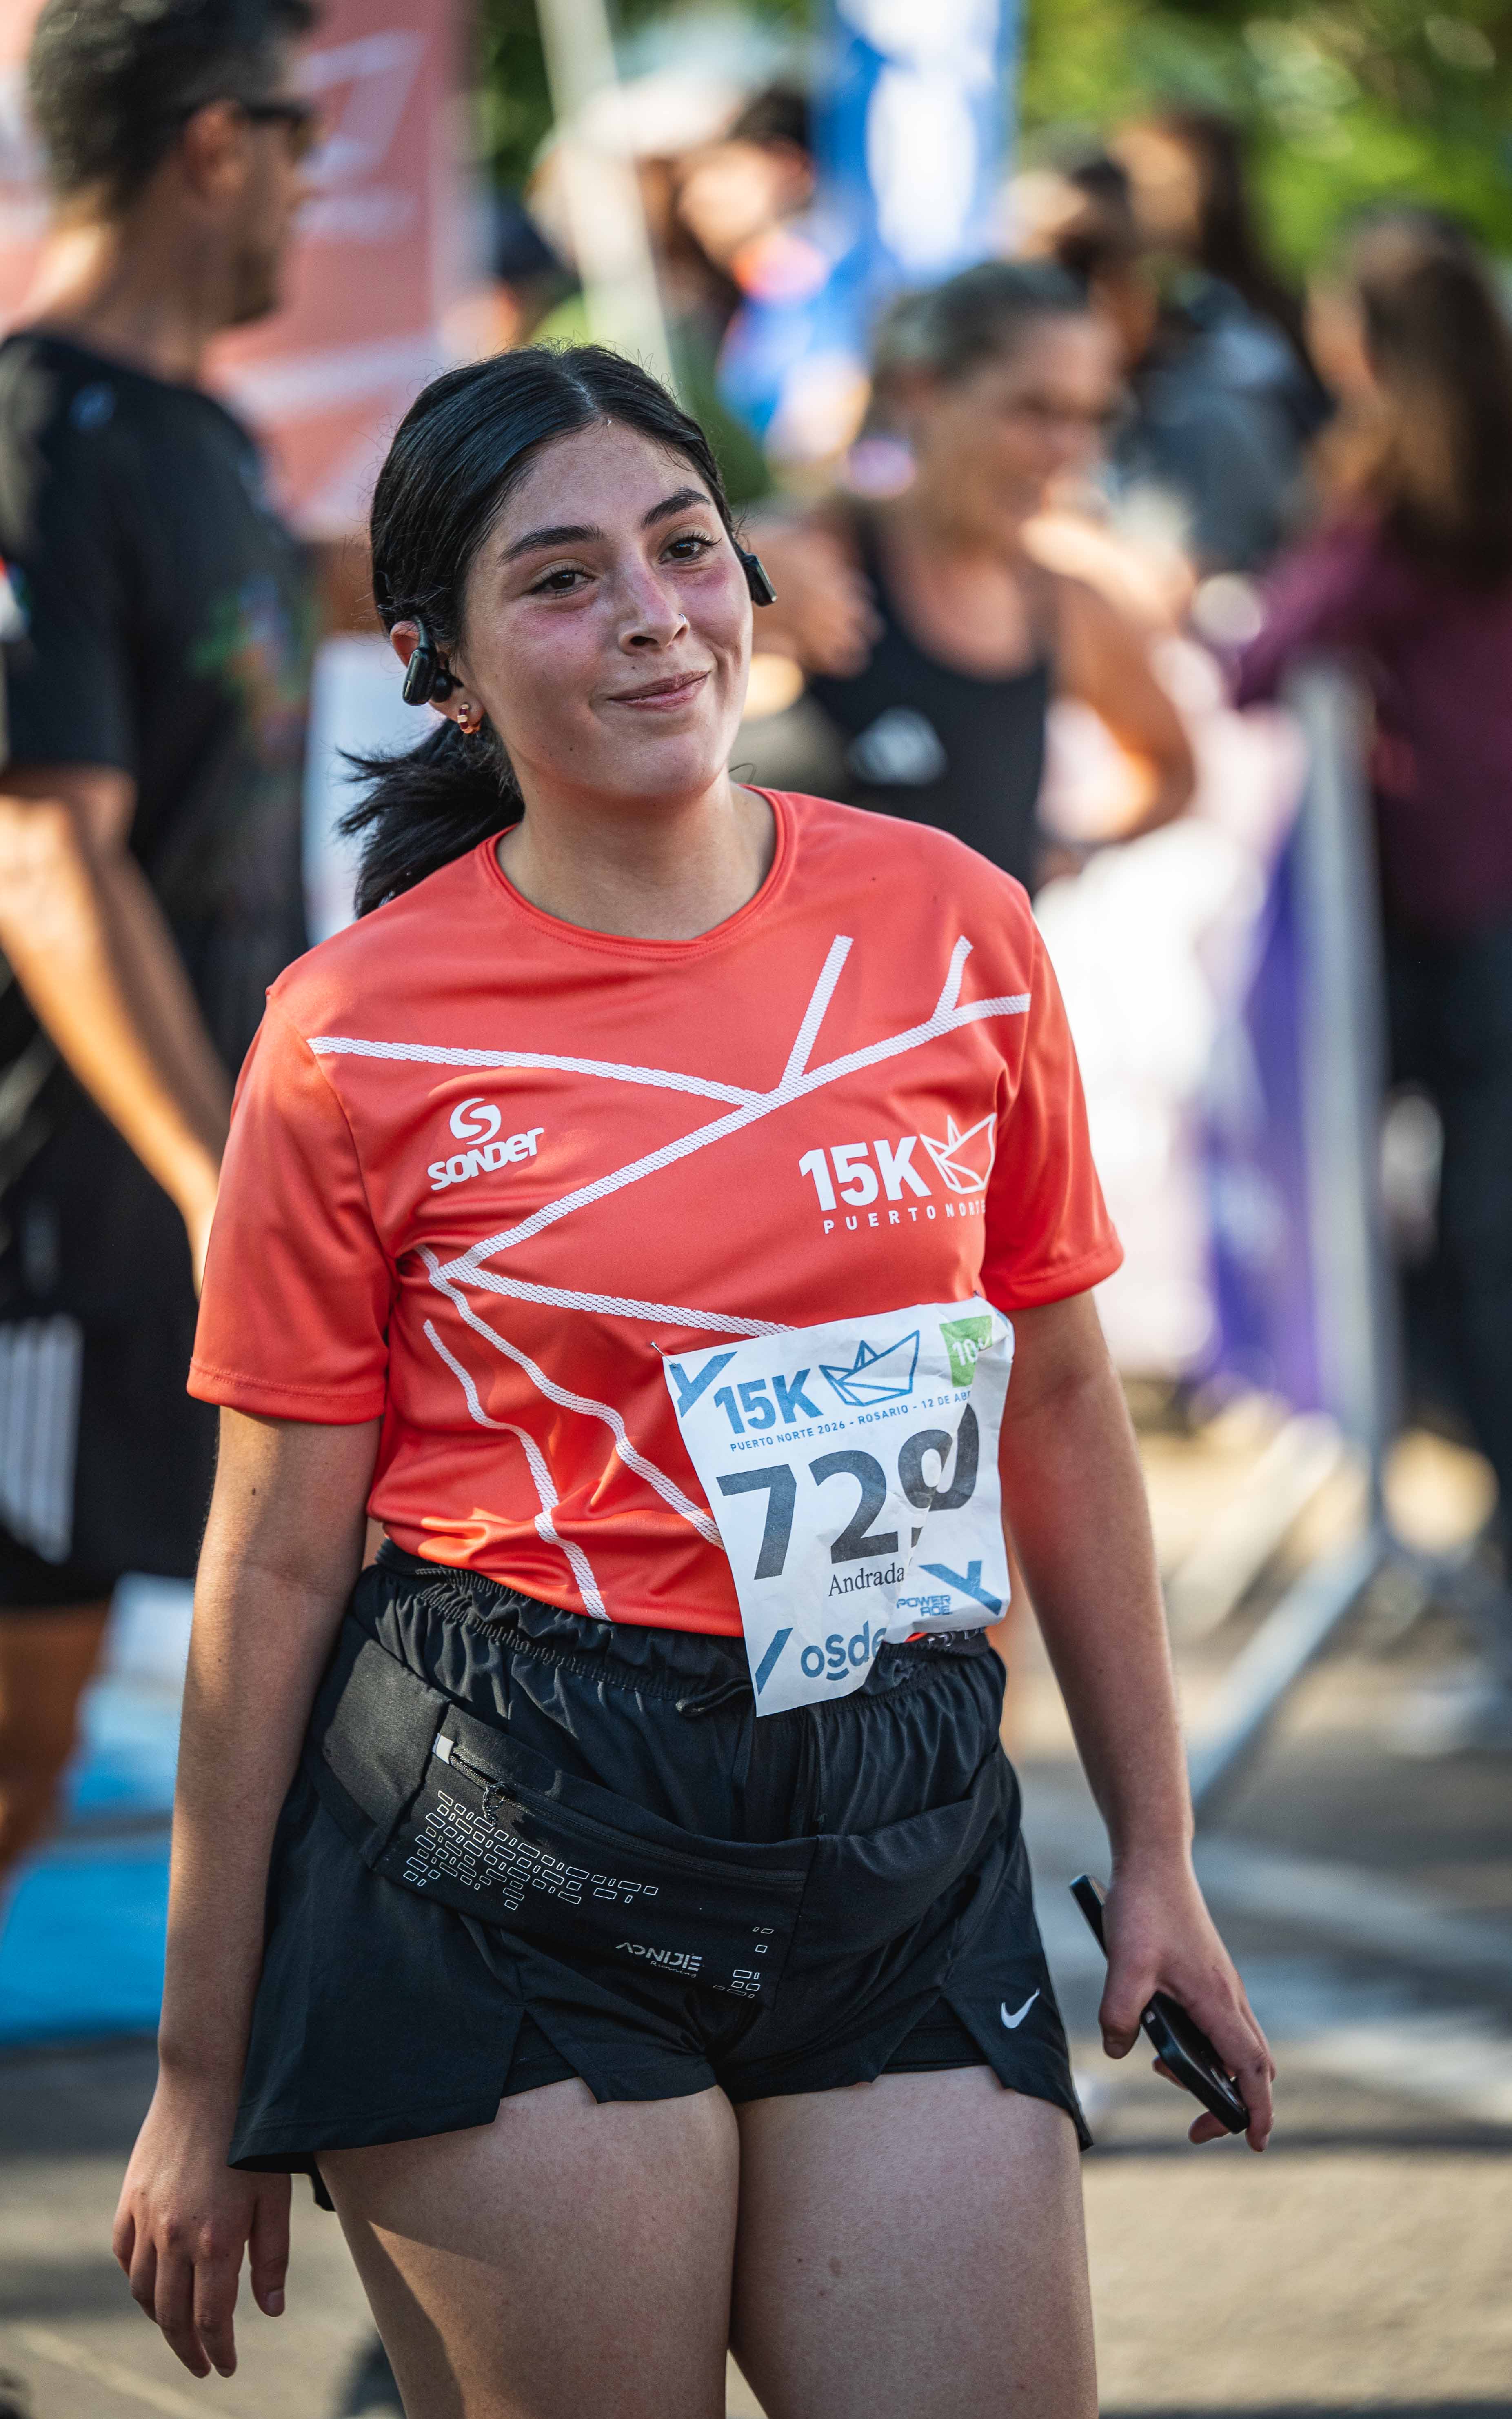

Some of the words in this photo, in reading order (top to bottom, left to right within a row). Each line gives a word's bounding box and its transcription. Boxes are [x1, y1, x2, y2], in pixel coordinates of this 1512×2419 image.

[798, 1136, 932, 1211] 15K
[823, 1205, 936, 1234] PUERTO
[945, 1199, 986, 1217] NORTE
[713, 1368, 824, 1434] 15K
[730, 1437, 773, 1452] PUERTO
[777, 1428, 814, 1443] NORTE
[818, 1421, 845, 1434] 2026
[858, 1405, 908, 1424] ROSARIO
[921, 1399, 934, 1408] 12
[937, 1395, 950, 1406] DE
[828, 1562, 904, 1597] Andrada
[897, 1595, 951, 1608] POWER
[650, 1960, 697, 1978] Running
